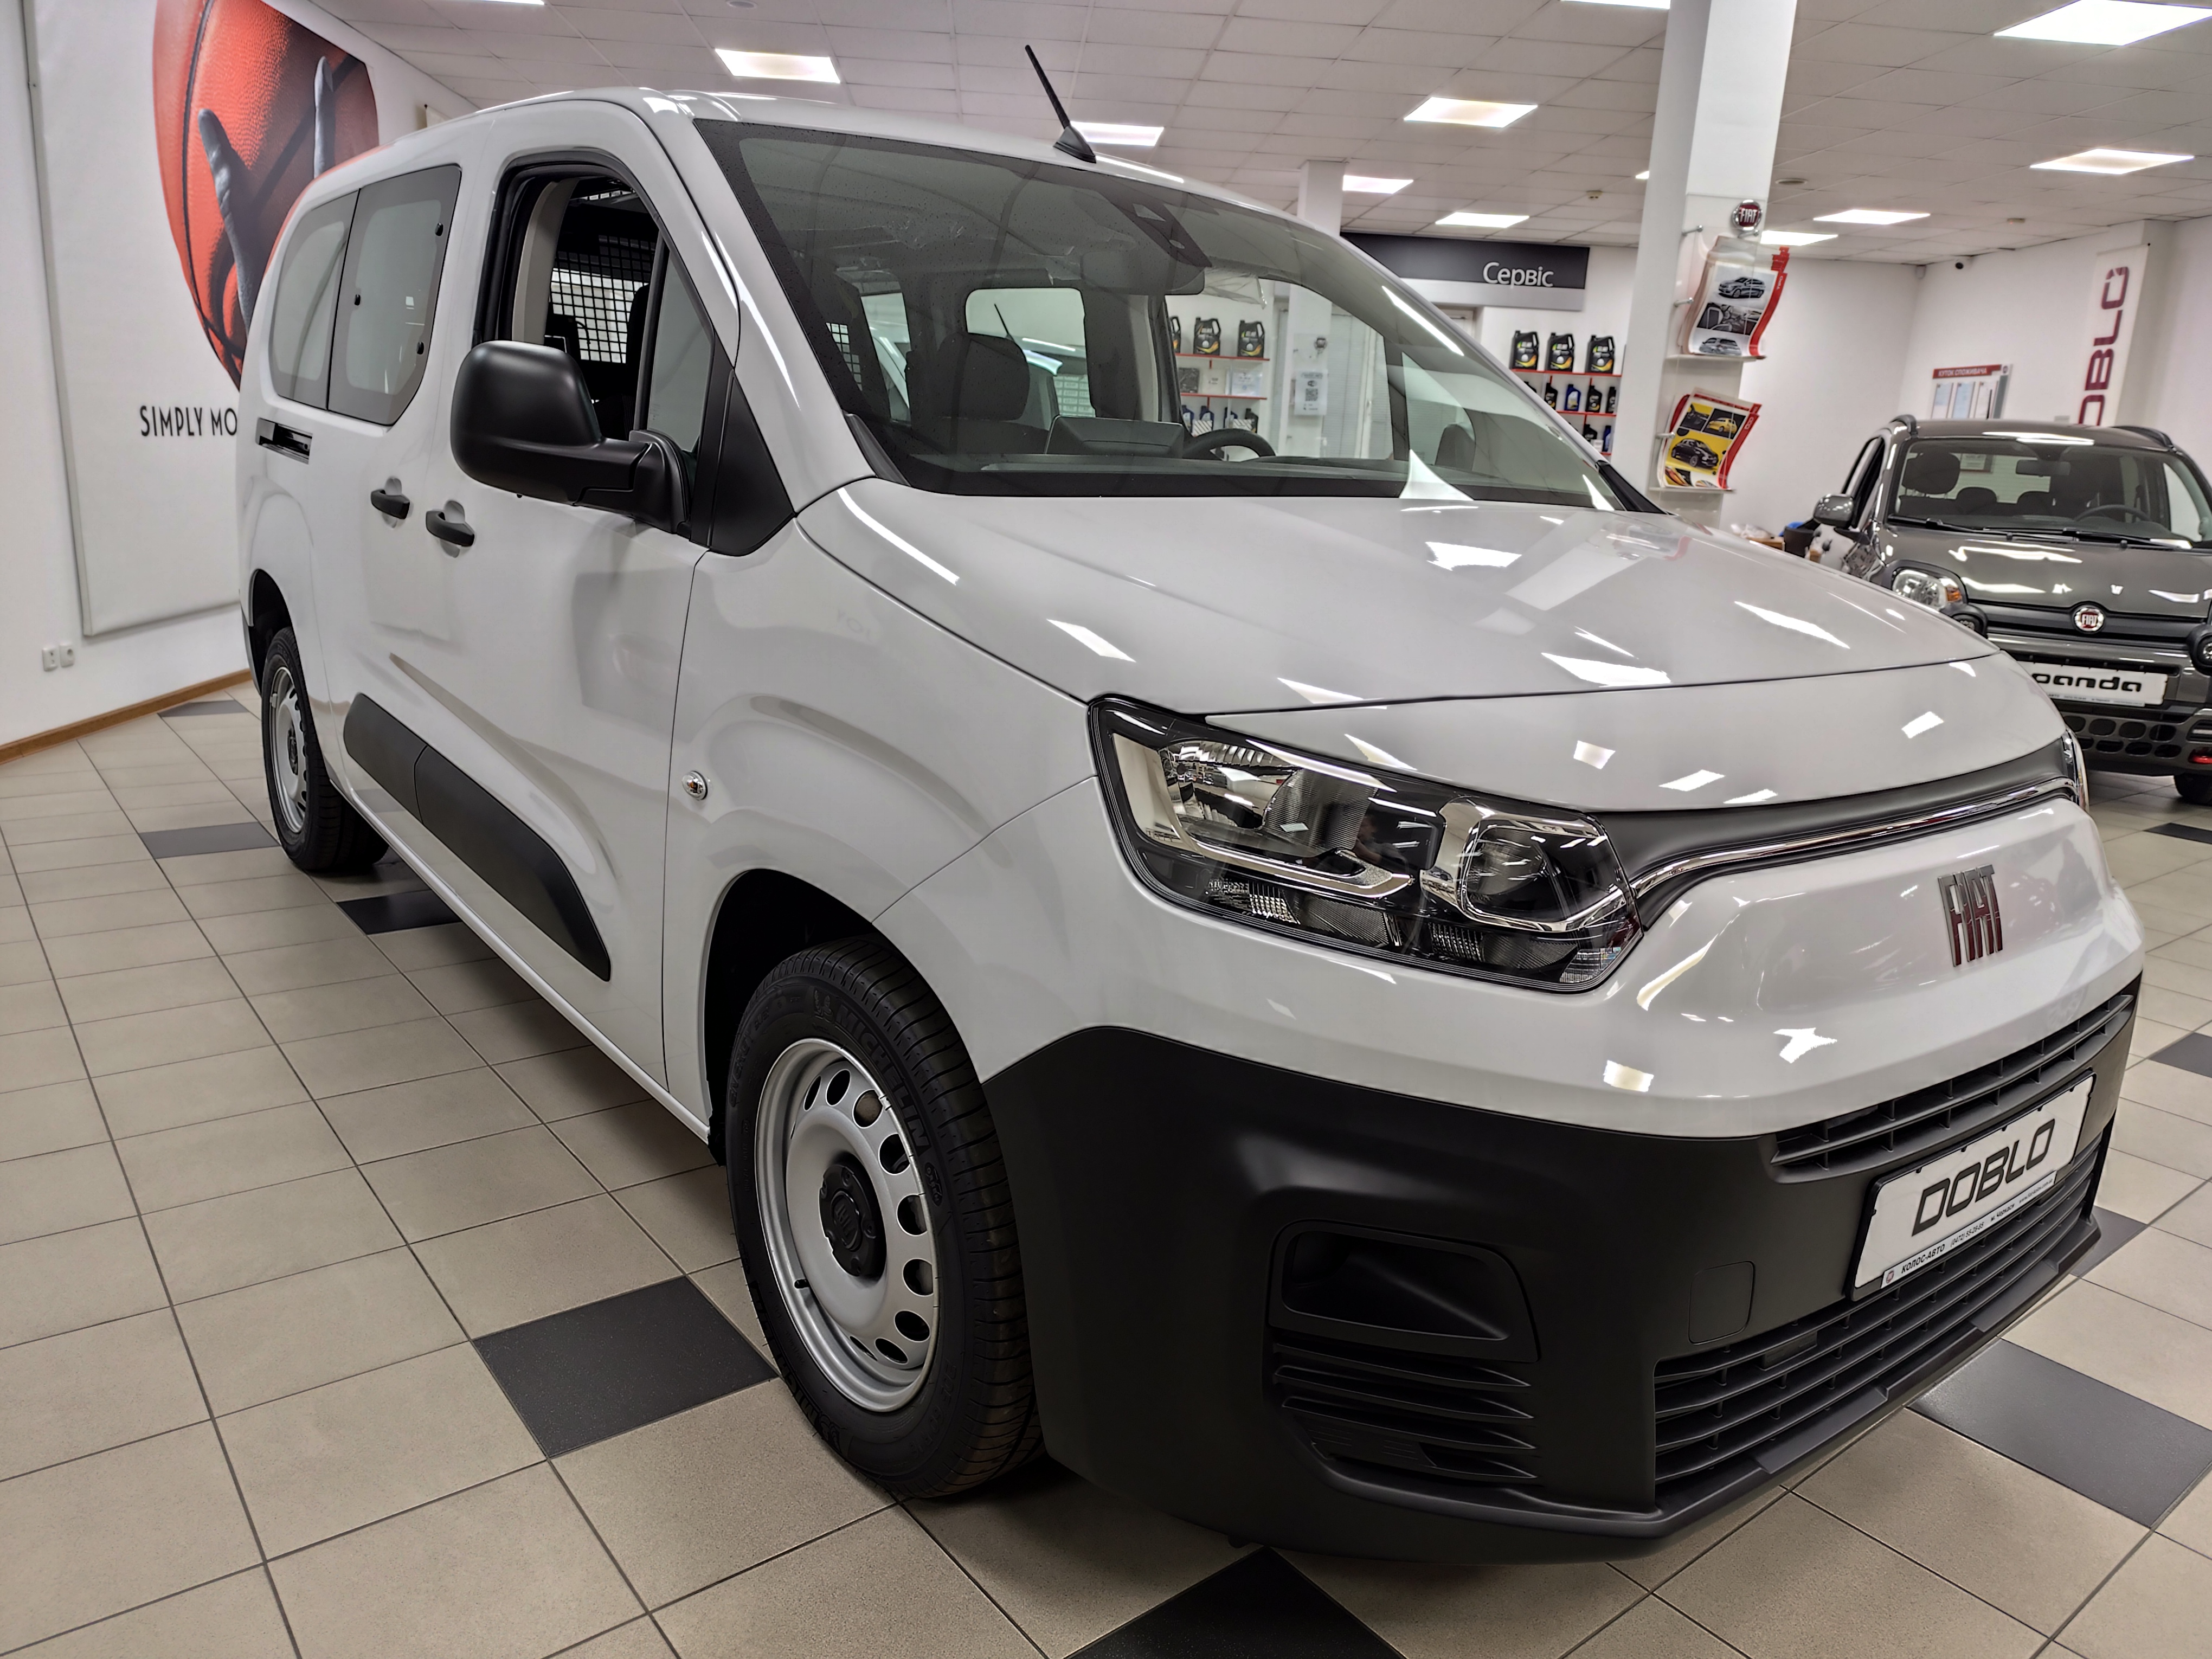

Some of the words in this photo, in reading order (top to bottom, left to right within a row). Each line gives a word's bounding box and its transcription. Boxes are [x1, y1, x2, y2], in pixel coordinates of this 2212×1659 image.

[1740, 207, 1758, 223] FIAT
[1483, 262, 1554, 289] Сервіс
[139, 405, 203, 436] SIMPLY
[2081, 614, 2098, 627] FIAT
[1937, 864, 2003, 967] FIAT
[835, 1004, 931, 1147] MICHELIN
[1912, 1118, 2055, 1237] DOBLO
[1901, 1244, 1945, 1274] КОЛОС-АВТО
